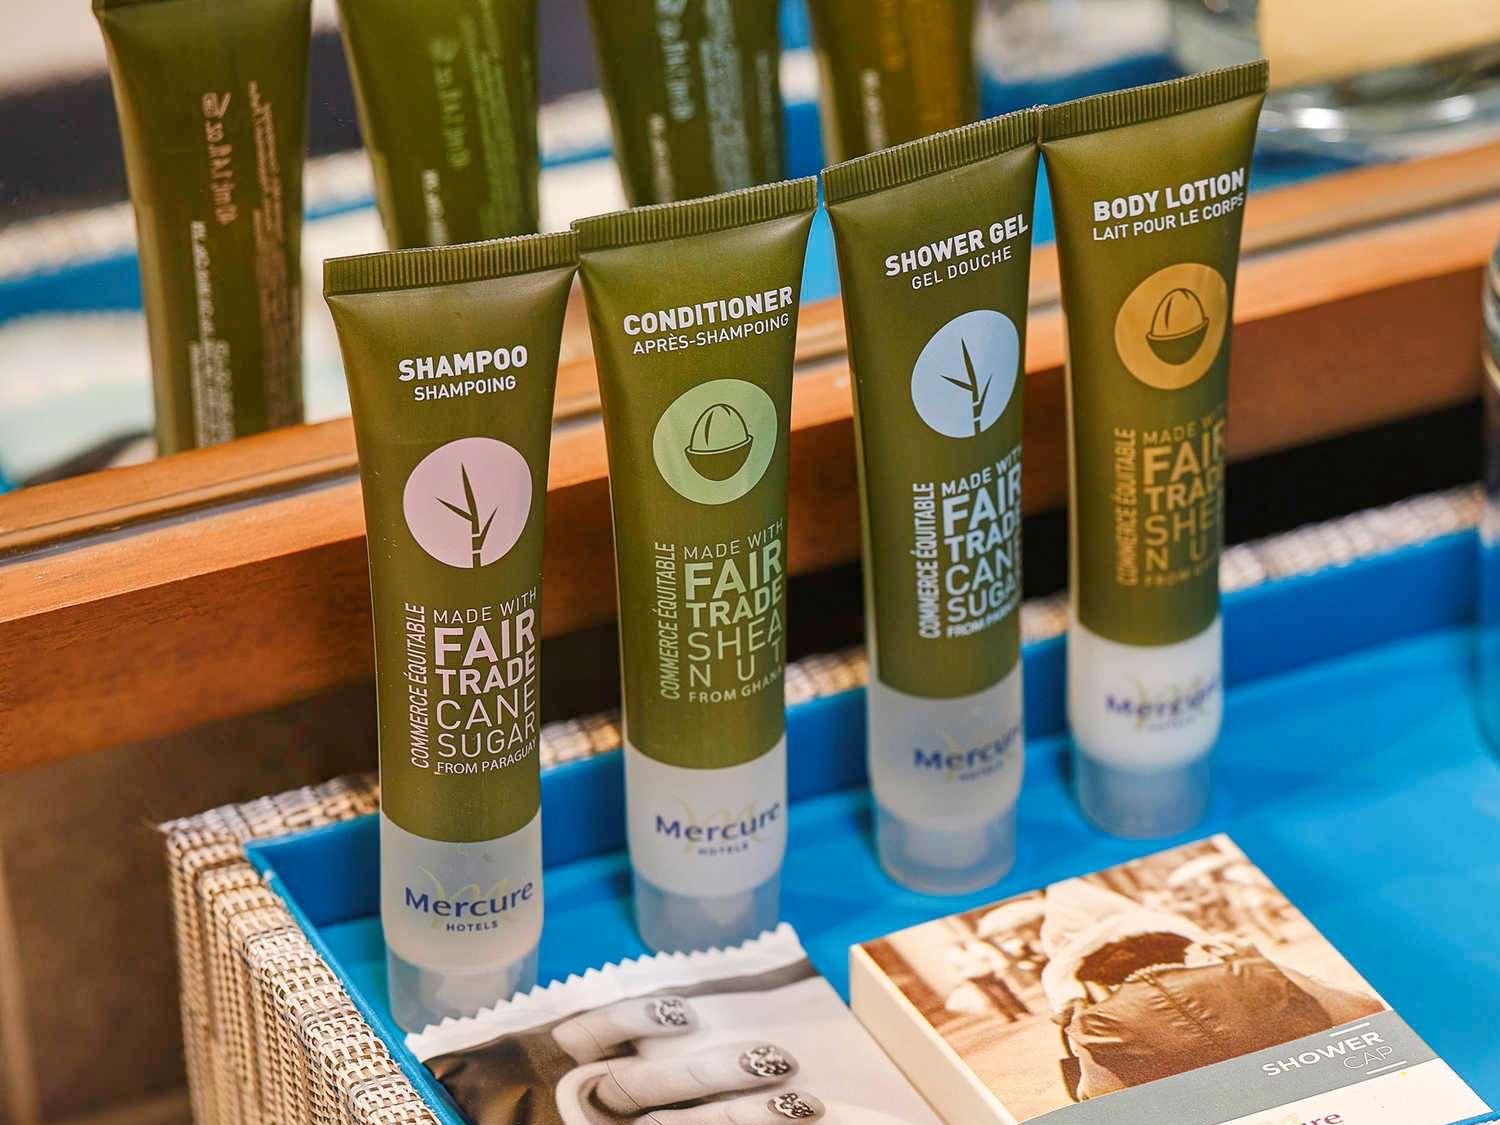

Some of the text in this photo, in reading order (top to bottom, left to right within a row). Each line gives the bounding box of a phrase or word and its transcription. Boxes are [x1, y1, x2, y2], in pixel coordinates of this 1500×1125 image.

[1093, 167, 1245, 222] BODY LOTION
[1093, 193, 1244, 241] LAIT POUR LE CORPS
[885, 213, 1029, 277] SHOWER GEL
[911, 246, 1012, 290] GEL DOUCHE
[623, 286, 793, 336] CONDITIONER
[632, 313, 789, 354] APRÈS-SHAMPOING
[398, 345, 528, 382] SHAMPOO
[414, 375, 516, 401] SHAMPOING
[1143, 421, 1197, 446] MADE
[941, 467, 992, 497] MADE
[942, 462, 1022, 537] FAIR
[684, 517, 784, 560] MADE WITH
[1144, 490, 1224, 547] SHE
[684, 539, 782, 601] FAIR
[433, 586, 537, 624] MADE WITH
[652, 541, 680, 700] COMMERCE ÉQUITABLE
[686, 574, 783, 628] TRADE
[916, 561, 941, 639] COMMERCE
[434, 608, 536, 666] FAIR
[688, 609, 783, 661] SHEA
[403, 603, 429, 768] COMMERCE ÉQUITABLE
[435, 644, 536, 695] TRADE
[436, 675, 536, 730] CANE
[689, 688, 737, 703] FROM
[437, 739, 536, 775] FROM PARAGUAY
[438, 711, 535, 758] SUGAR
[405, 881, 533, 917] Mercure
[446, 920, 498, 932] HOTELS
[1262, 1030, 1385, 1076] SHOWER
[1344, 1045, 1393, 1069] CAP
